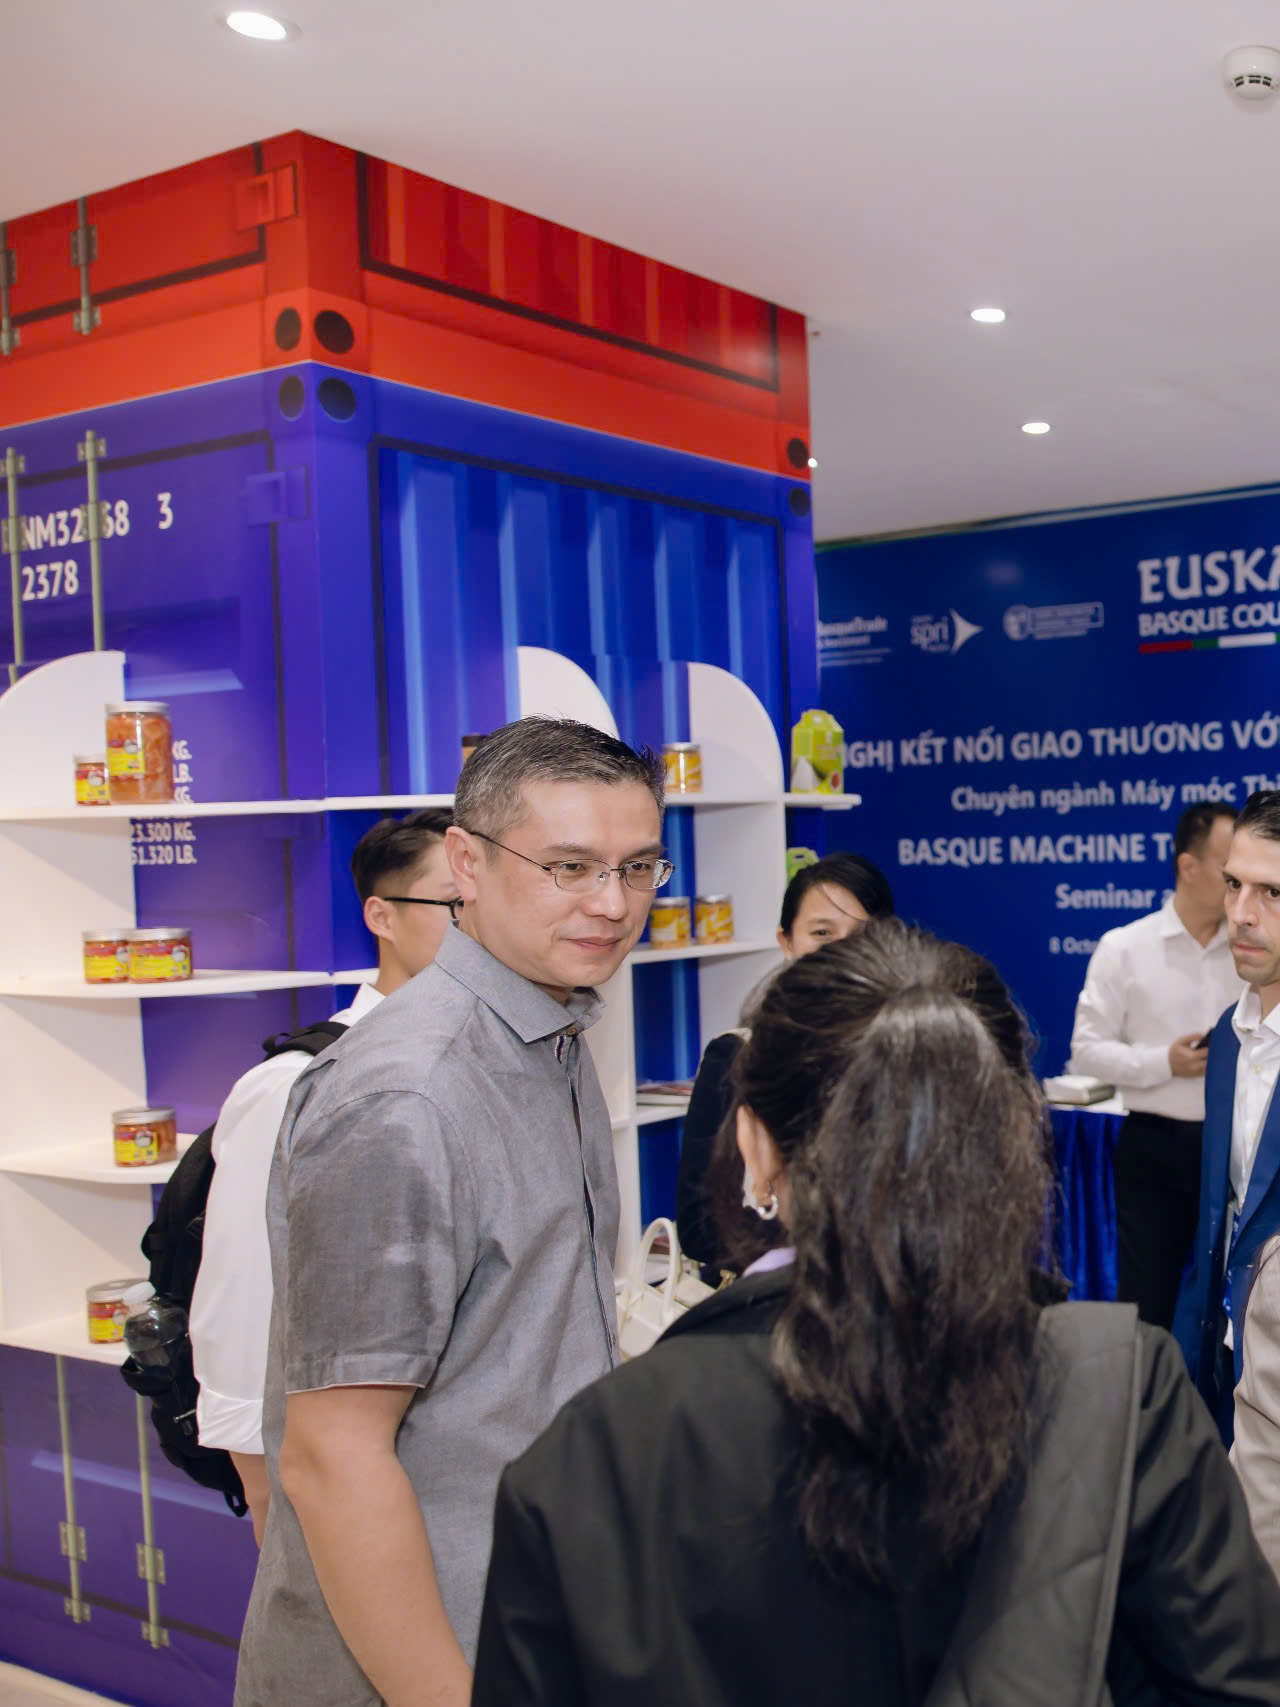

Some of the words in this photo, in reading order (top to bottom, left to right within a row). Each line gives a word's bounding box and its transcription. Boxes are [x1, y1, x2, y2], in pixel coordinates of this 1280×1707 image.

[157, 492, 174, 530] 3
[22, 559, 79, 601] 2378
[1138, 608, 1230, 638] BASQUE
[900, 729, 947, 766] KẾT
[953, 725, 1004, 764] NỐI
[1010, 729, 1083, 761] GIAO
[1088, 719, 1223, 757] THƯƠNG
[950, 782, 1035, 817] Chuyên
[1041, 780, 1116, 815] ngành
[1121, 778, 1174, 811] Máy
[1181, 773, 1236, 804] móc
[898, 837, 1003, 868] BASQUE
[1009, 833, 1146, 864] MACHINE
[1055, 882, 1157, 910] Seminar
